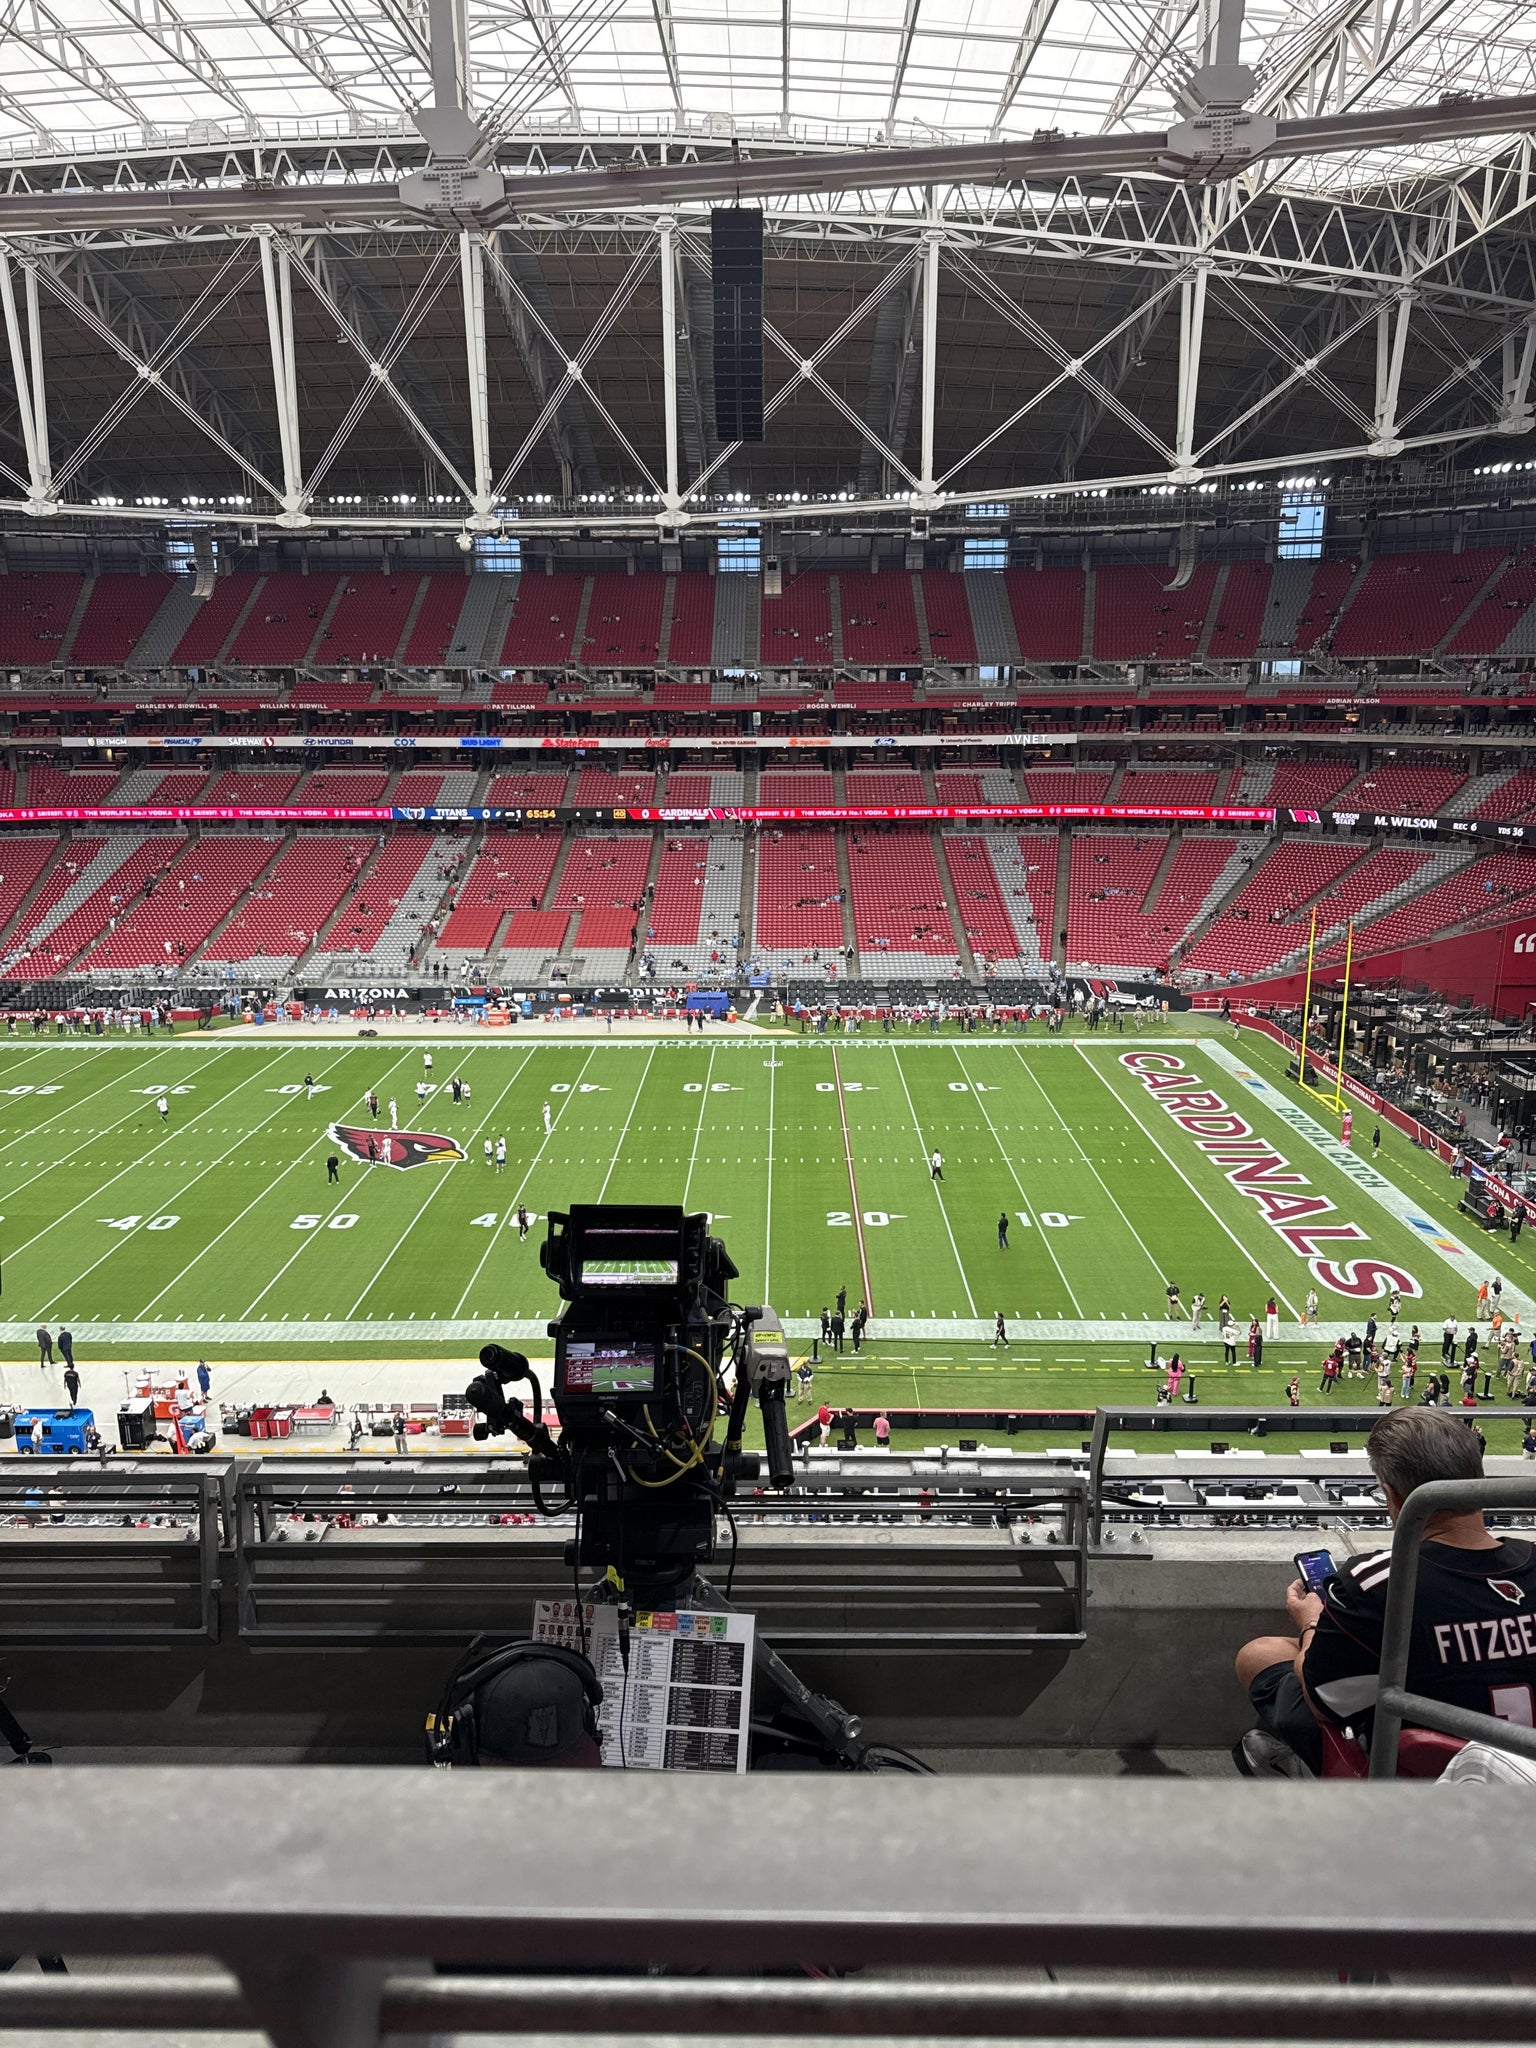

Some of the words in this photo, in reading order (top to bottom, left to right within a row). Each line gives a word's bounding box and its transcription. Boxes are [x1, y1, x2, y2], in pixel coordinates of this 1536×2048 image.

[228, 738, 263, 746] SAFEWAY
[1004, 735, 1048, 744] AVNET
[482, 809, 490, 818] 0
[526, 810, 556, 818] 65:54
[642, 809, 649, 818] 0
[1332, 812, 1360, 820] SEASON
[1374, 816, 1388, 826] M.
[1391, 817, 1437, 829] WILSON
[1453, 822, 1468, 831] REC
[1470, 822, 1478, 832] 6
[1498, 827, 1511, 835] YDS
[1512, 827, 1524, 837] 36
[325, 988, 409, 999] ARIZONA
[1323, 1064, 1345, 1086] ARIZOA
[1346, 1079, 1376, 1105] CARDINALS
[1276, 1108, 1338, 1148] CRUCIAL
[1328, 1153, 1389, 1187] CATCH
[1118, 1052, 1423, 1299] CARDINALS
[108, 1215, 181, 1230] 40
[289, 1214, 360, 1230] 50
[826, 1212, 890, 1226] 20
[1015, 1212, 1070, 1227] 10
[1434, 1614, 1536, 1664] FITZGE
